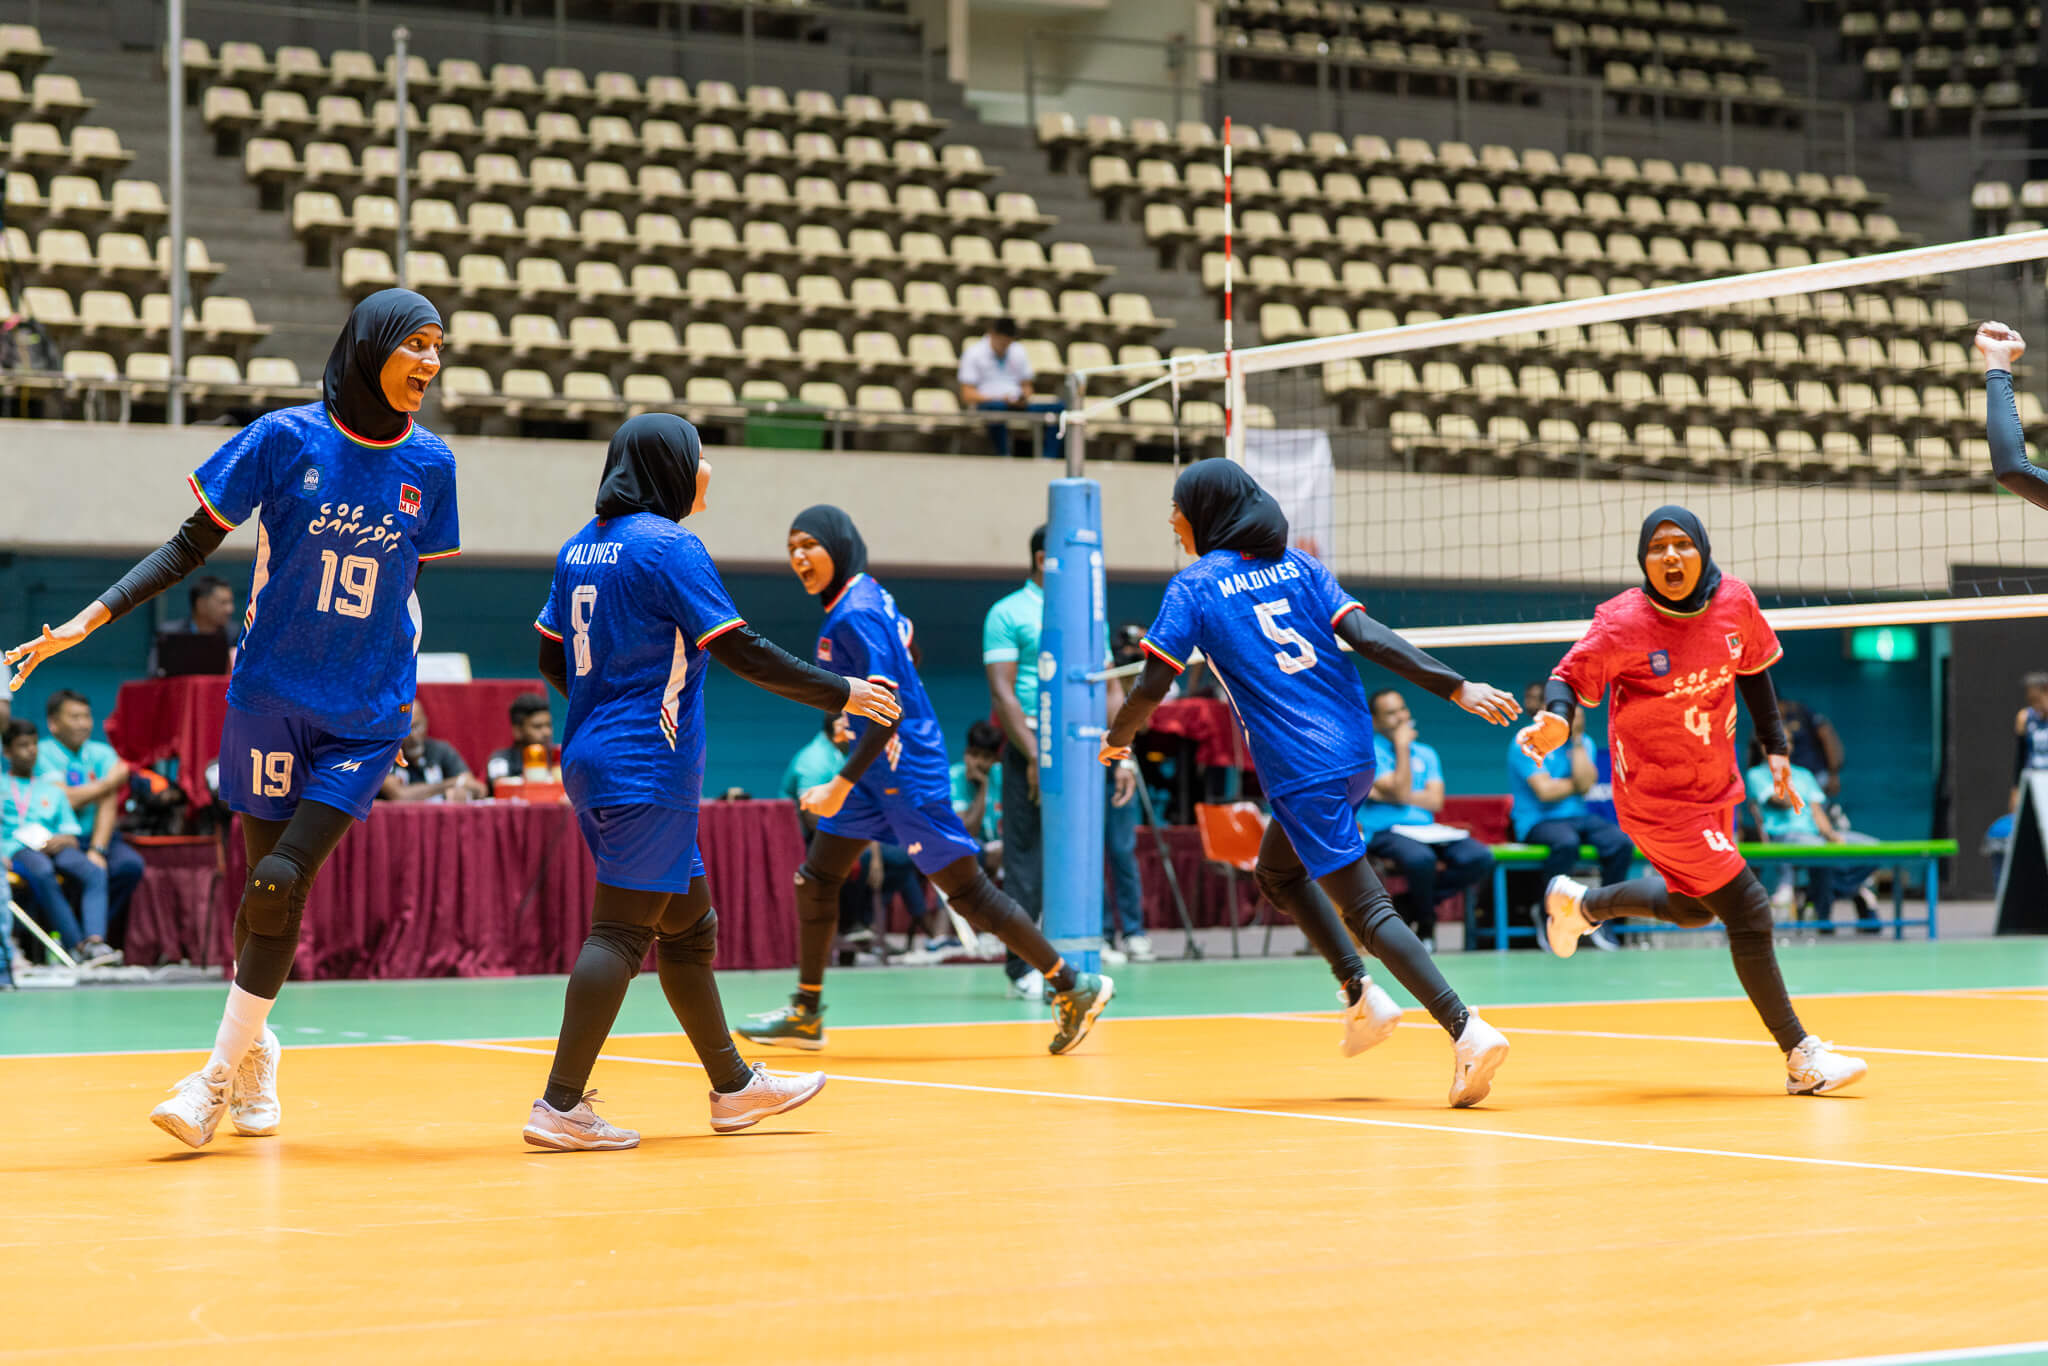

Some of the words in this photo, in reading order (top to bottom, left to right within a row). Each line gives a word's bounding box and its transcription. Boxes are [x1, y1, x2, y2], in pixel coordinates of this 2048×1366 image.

[565, 542, 624, 565] MALDIVES
[316, 549, 379, 620] 19
[1217, 561, 1300, 599] MALDIVES
[571, 585, 598, 677] 8
[1252, 598, 1318, 676] 5
[1684, 705, 1712, 745] 4
[250, 748, 295, 798] 19
